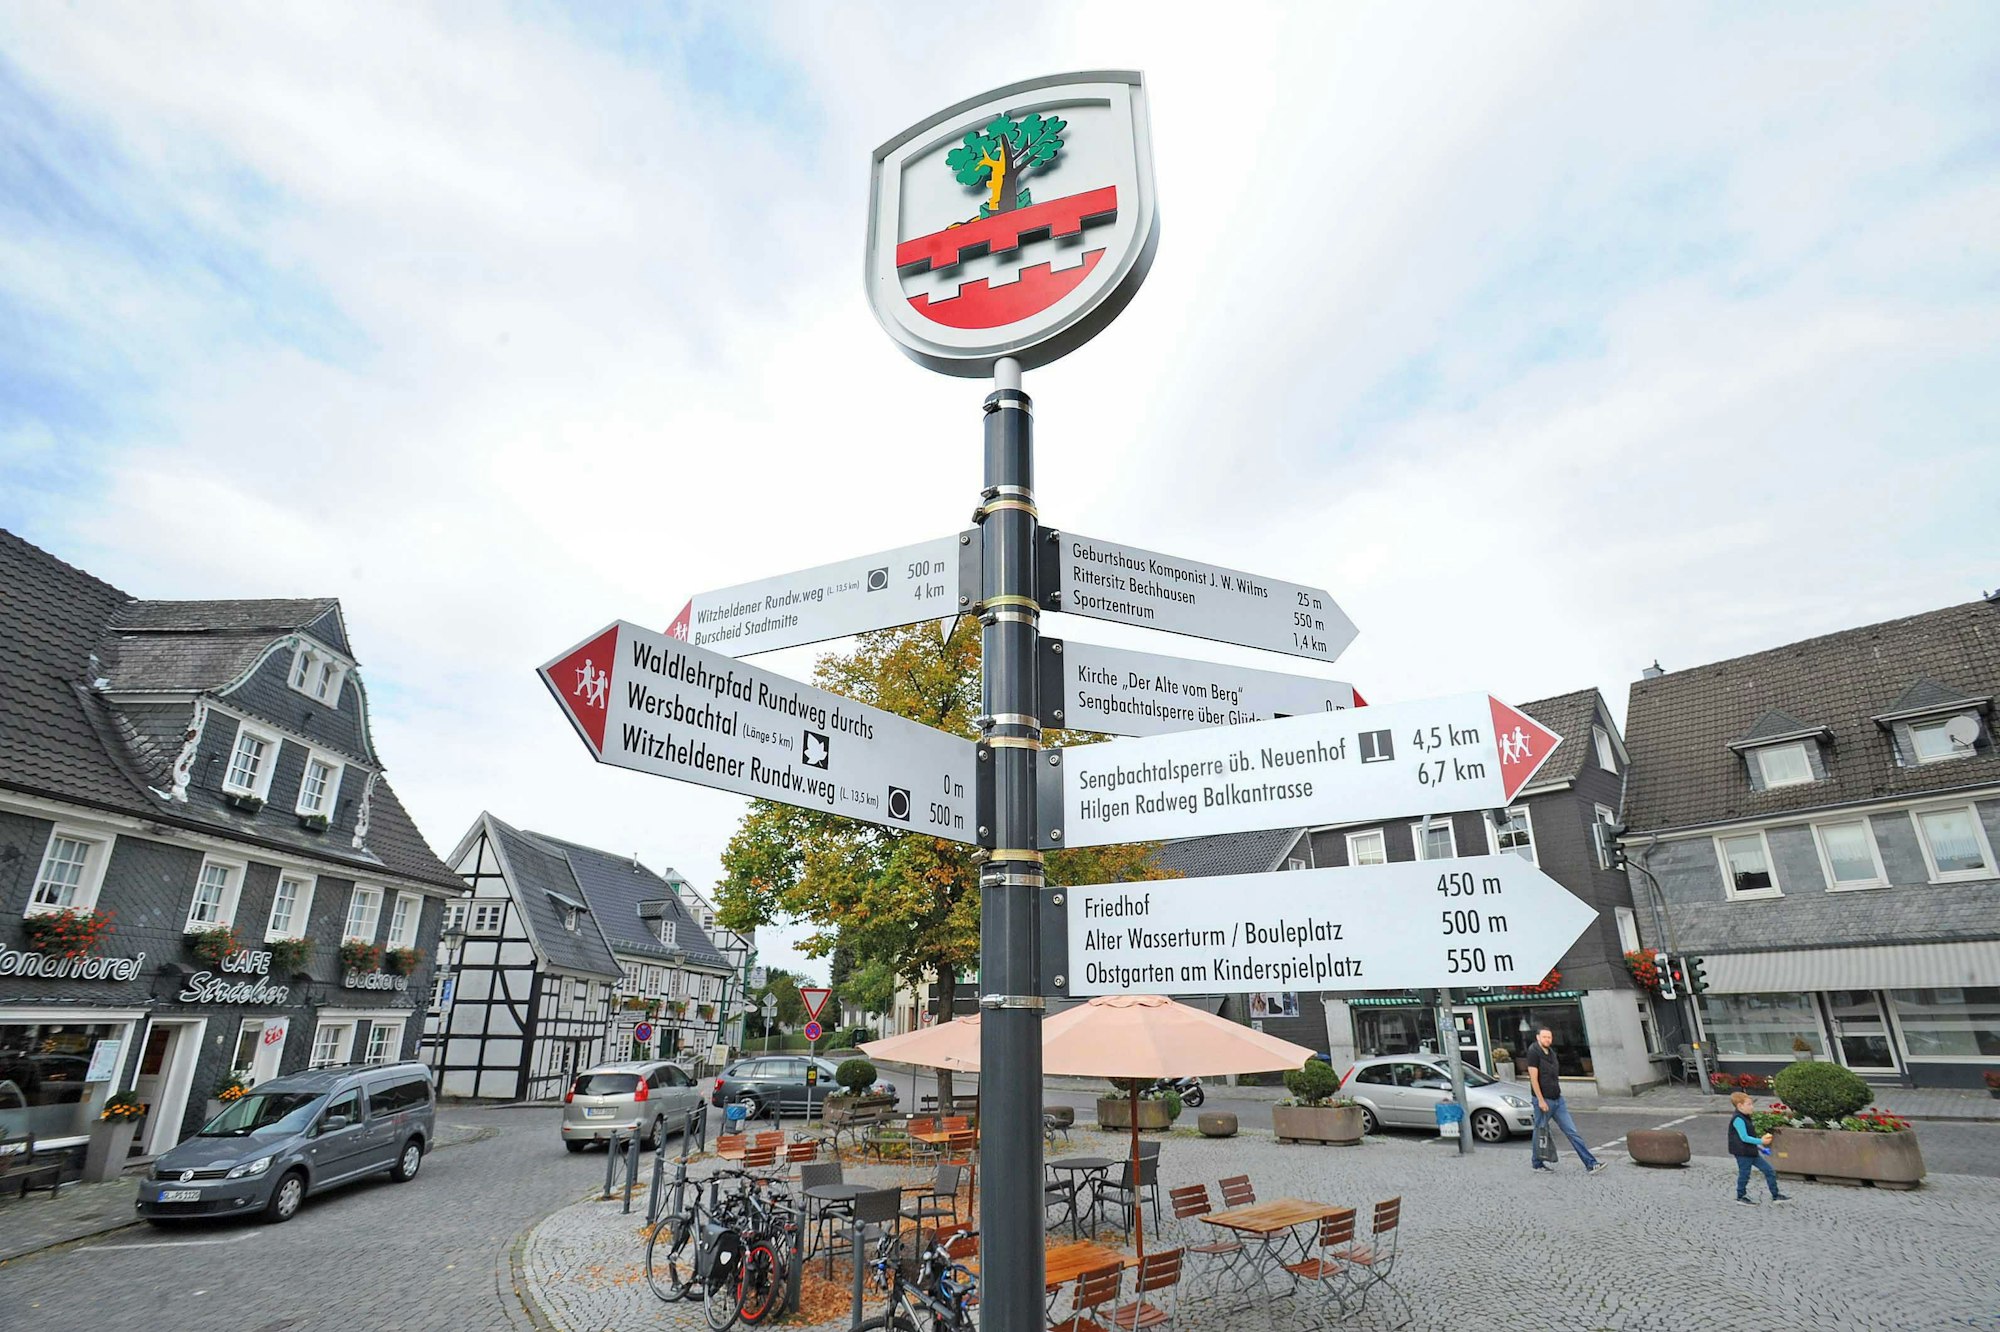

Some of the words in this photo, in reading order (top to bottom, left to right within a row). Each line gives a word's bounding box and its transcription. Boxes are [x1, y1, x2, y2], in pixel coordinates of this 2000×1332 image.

[698, 601, 762, 624] Witzheldener
[765, 588, 824, 610] Rundw.weg
[826, 586, 834, 596] (L.
[836, 582, 848, 592] 13,5
[848, 580, 860, 590] km)
[907, 560, 930, 580] 500
[934, 561, 945, 574] m
[1072, 542, 1146, 572] Geburtshaus
[1149, 558, 1207, 585] Komponist
[1210, 572, 1218, 588] J.
[1220, 574, 1234, 591] W.
[1236, 578, 1268, 598] Wilms
[1297, 592, 1310, 607] 25
[1312, 599, 1322, 610] m
[1073, 566, 1126, 591] Rittersitz
[1129, 577, 1196, 605] Bechhausen
[1294, 612, 1312, 628] 550
[1315, 620, 1324, 631] m
[694, 622, 742, 646] Burscheid
[744, 614, 798, 636] Stadtmitte
[914, 585, 922, 600] 4
[926, 582, 944, 599] km
[1073, 589, 1154, 620] Sportzentrum
[1293, 632, 1308, 650] 1,4
[1311, 635, 1327, 653] km
[633, 640, 753, 702] Waldlehrpfad
[758, 682, 826, 730] Rundweg
[831, 706, 873, 740] durchs
[1078, 665, 1118, 686] Kirche
[1154, 676, 1178, 694] Alte
[1182, 684, 1207, 698] vom
[1078, 690, 1194, 722] Sengbachtalsperre
[1198, 706, 1225, 725] über
[628, 681, 738, 737] Wersbachtal
[742, 722, 770, 744] (Länge
[771, 732, 777, 744] 5
[778, 733, 794, 752] km)
[944, 774, 950, 795] 0
[954, 783, 964, 799] m
[1080, 759, 1223, 792] Sengbachtalsperre
[1229, 750, 1255, 773] üb.
[1261, 737, 1346, 769] Neuenhof
[1413, 726, 1442, 754] 4,5
[1448, 724, 1480, 746] km
[623, 722, 745, 778] Witzheldener
[750, 756, 835, 805] Rundw.weg
[840, 786, 849, 802] (L.
[851, 789, 865, 804] 13,5
[866, 792, 879, 809] km)
[929, 802, 950, 827] 500
[954, 814, 964, 830] m
[1081, 798, 1129, 822] Hilgen
[1136, 790, 1198, 814] Radweg
[1203, 782, 1313, 808] Balkantrasse
[1418, 760, 1446, 788] 6,7
[1453, 757, 1486, 781] km
[1085, 892, 1150, 918] Friedhof
[1437, 872, 1474, 897] 450
[1482, 877, 1502, 895] m
[1085, 928, 1123, 951] Alter
[1127, 927, 1225, 949] Wasserturm
[1232, 922, 1238, 948] /
[1245, 917, 1344, 948] Bouleplatz
[1442, 909, 1480, 935] 500
[1488, 915, 1508, 933] m
[1086, 961, 1174, 988] Obstgarten
[1180, 966, 1207, 982] am
[1213, 952, 1363, 985] Kinderspielplatz
[1447, 947, 1486, 974] 550
[1494, 954, 1514, 972] m
